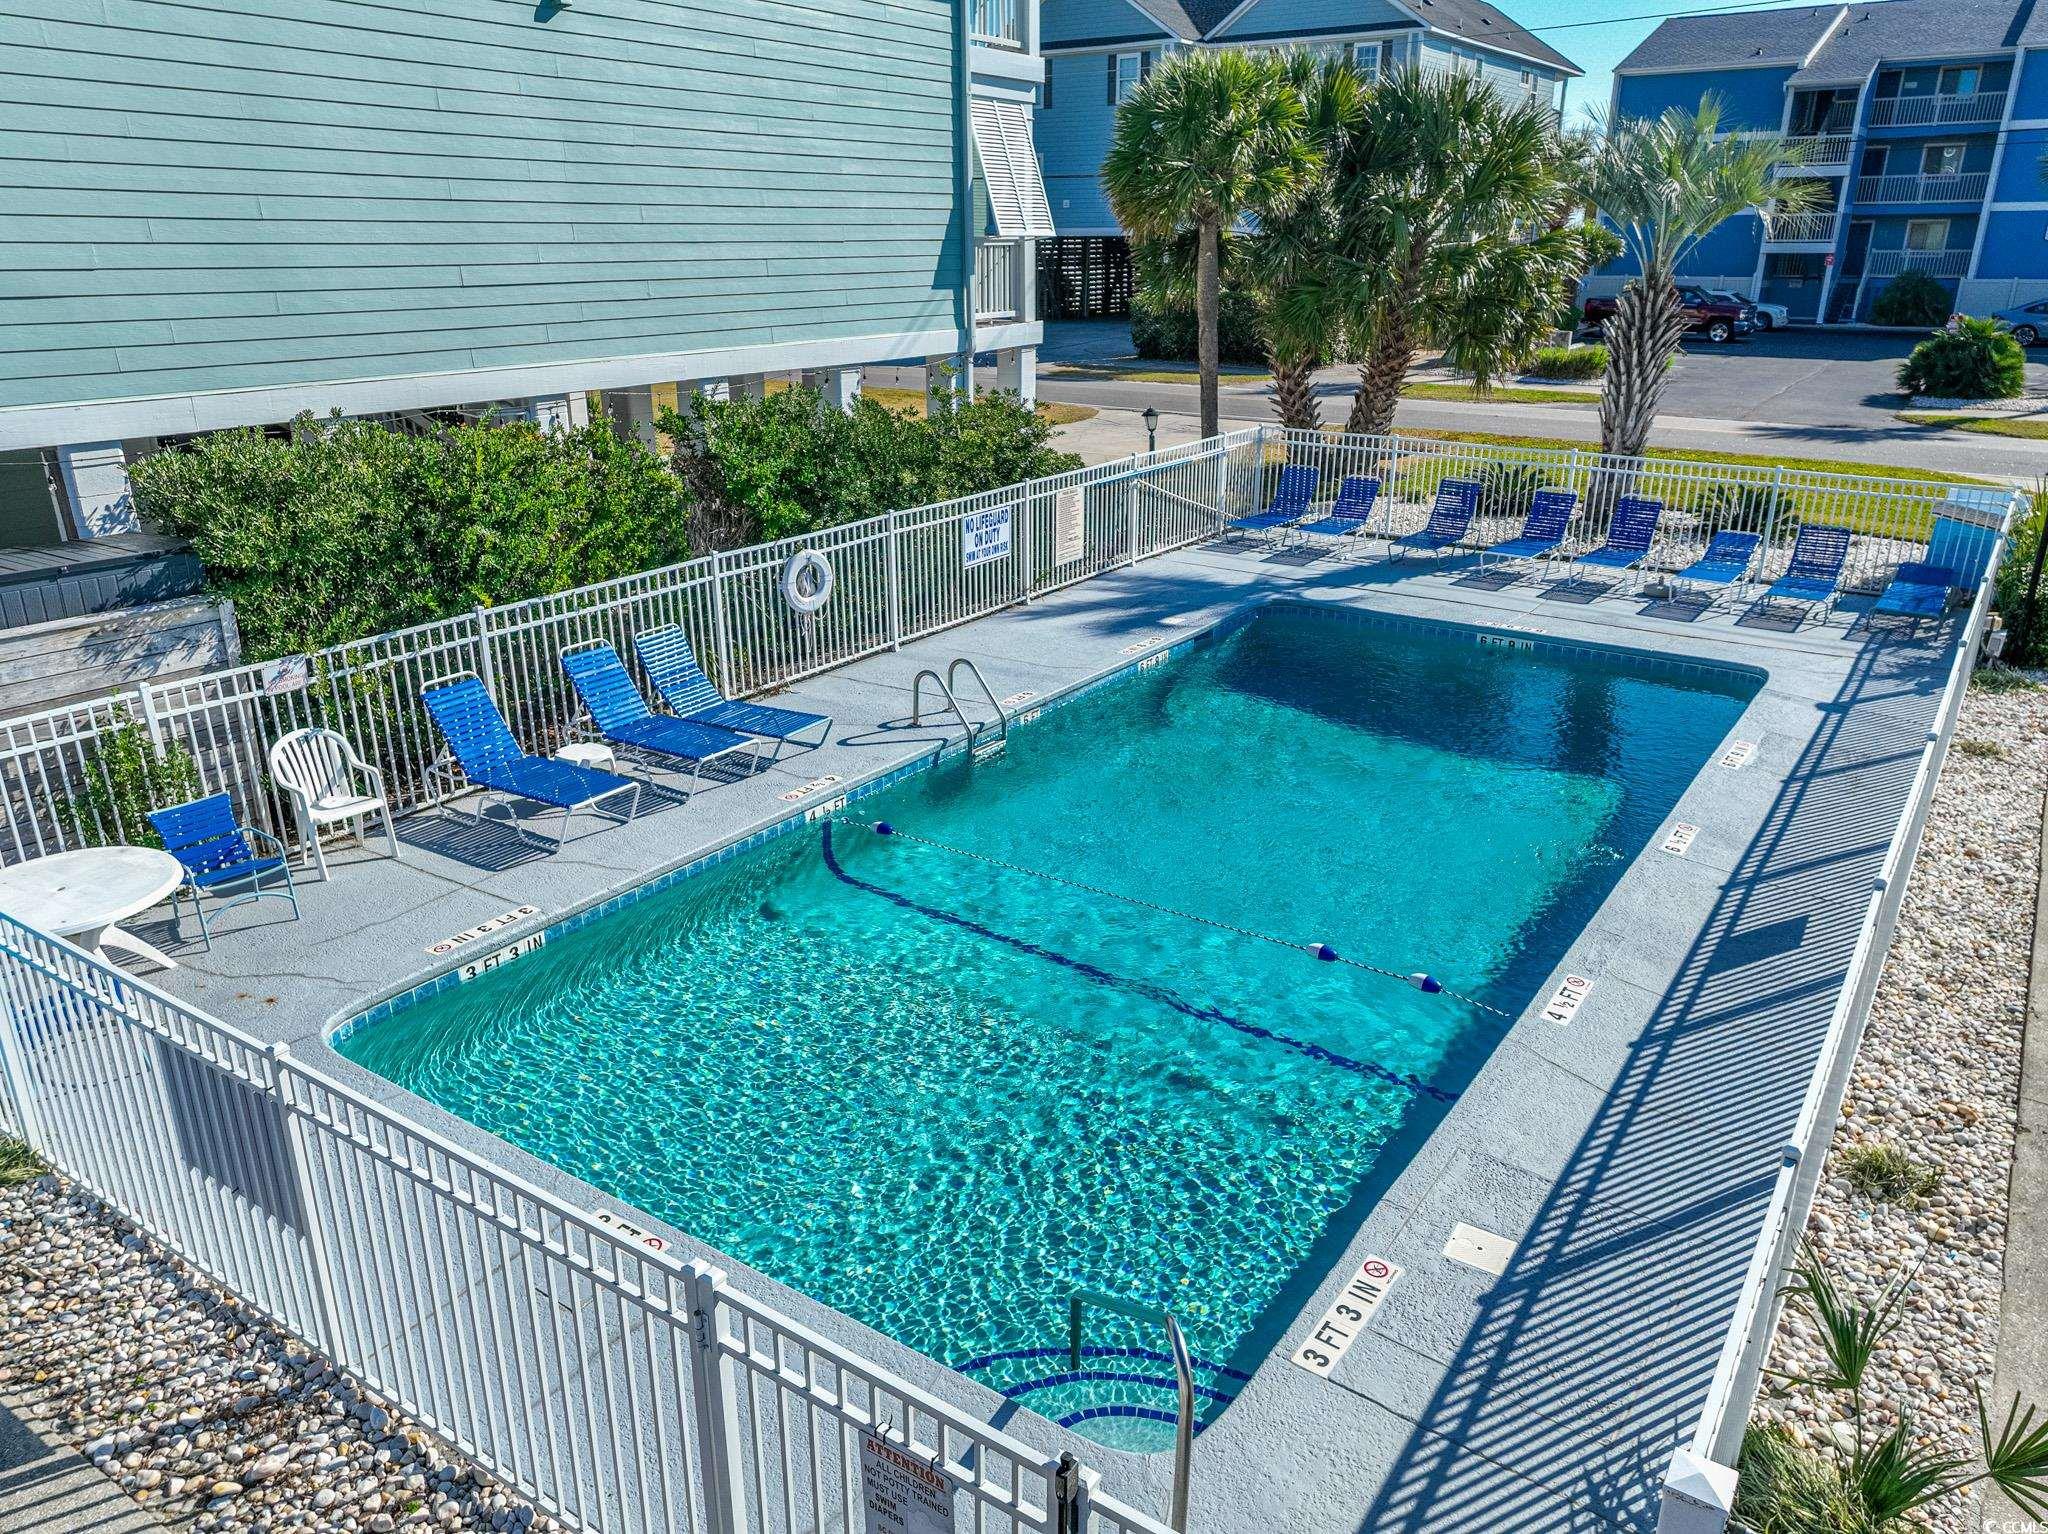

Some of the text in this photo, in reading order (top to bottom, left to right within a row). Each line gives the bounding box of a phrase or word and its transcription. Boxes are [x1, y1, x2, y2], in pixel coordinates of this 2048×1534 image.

[965, 508, 1009, 534] NO LIFEGUARD
[966, 551, 976, 563] SWIM
[981, 546, 991, 558] YOUR
[1000, 541, 1009, 552] RISK
[974, 527, 1000, 548] ON DUTY
[809, 810, 817, 821] 4
[834, 797, 846, 811] FT
[1673, 830, 1692, 841] FT
[451, 907, 534, 944] 3 FT 3 IN
[465, 934, 543, 980] 3 FT 3 IN
[1547, 1011, 1568, 1021] 4
[1559, 986, 1583, 1002] FT
[1302, 1279, 1382, 1368] 3 FT 3 IN
[866, 1438, 945, 1490] ATTENTION
[864, 1464, 949, 1518] NOT POTTY TRAINED
[866, 1477, 908, 1506] MUST USE
[876, 1460, 937, 1500] ALL CHILDREN
[869, 1500, 905, 1526] DIAPERS
[875, 1493, 897, 1512] SWIM
